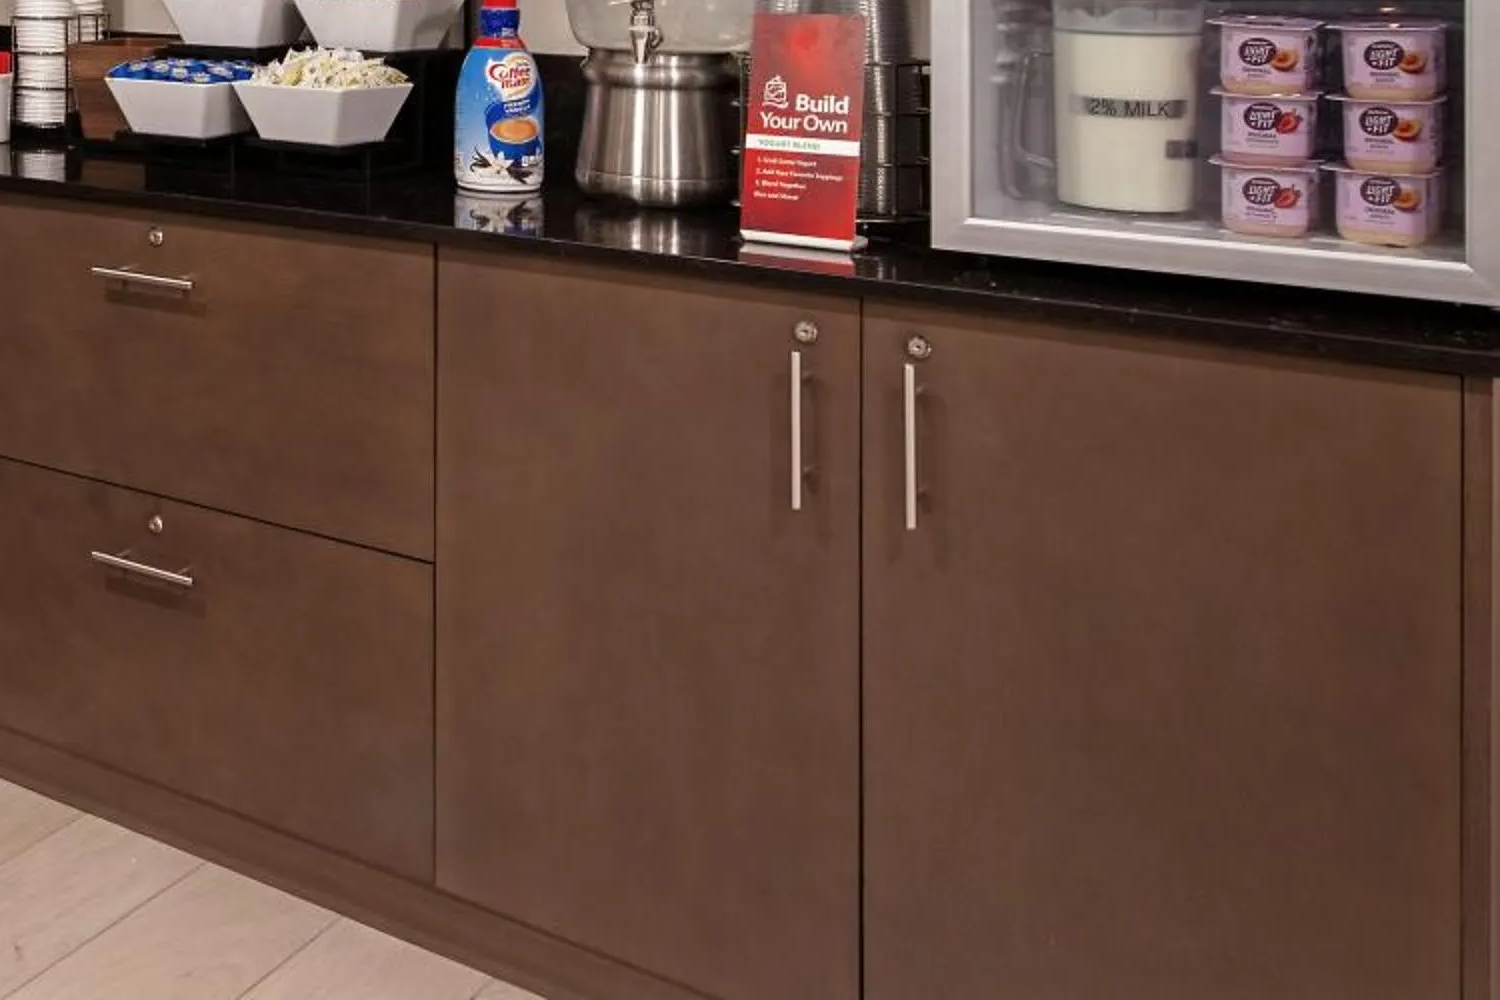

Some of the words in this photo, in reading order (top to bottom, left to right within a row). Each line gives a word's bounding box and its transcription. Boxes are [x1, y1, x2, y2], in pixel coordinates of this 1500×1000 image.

[795, 93, 850, 115] Build
[1090, 98, 1117, 117] 2%
[1124, 100, 1171, 118] MILK
[760, 111, 801, 130] Your
[803, 114, 848, 134] Own
